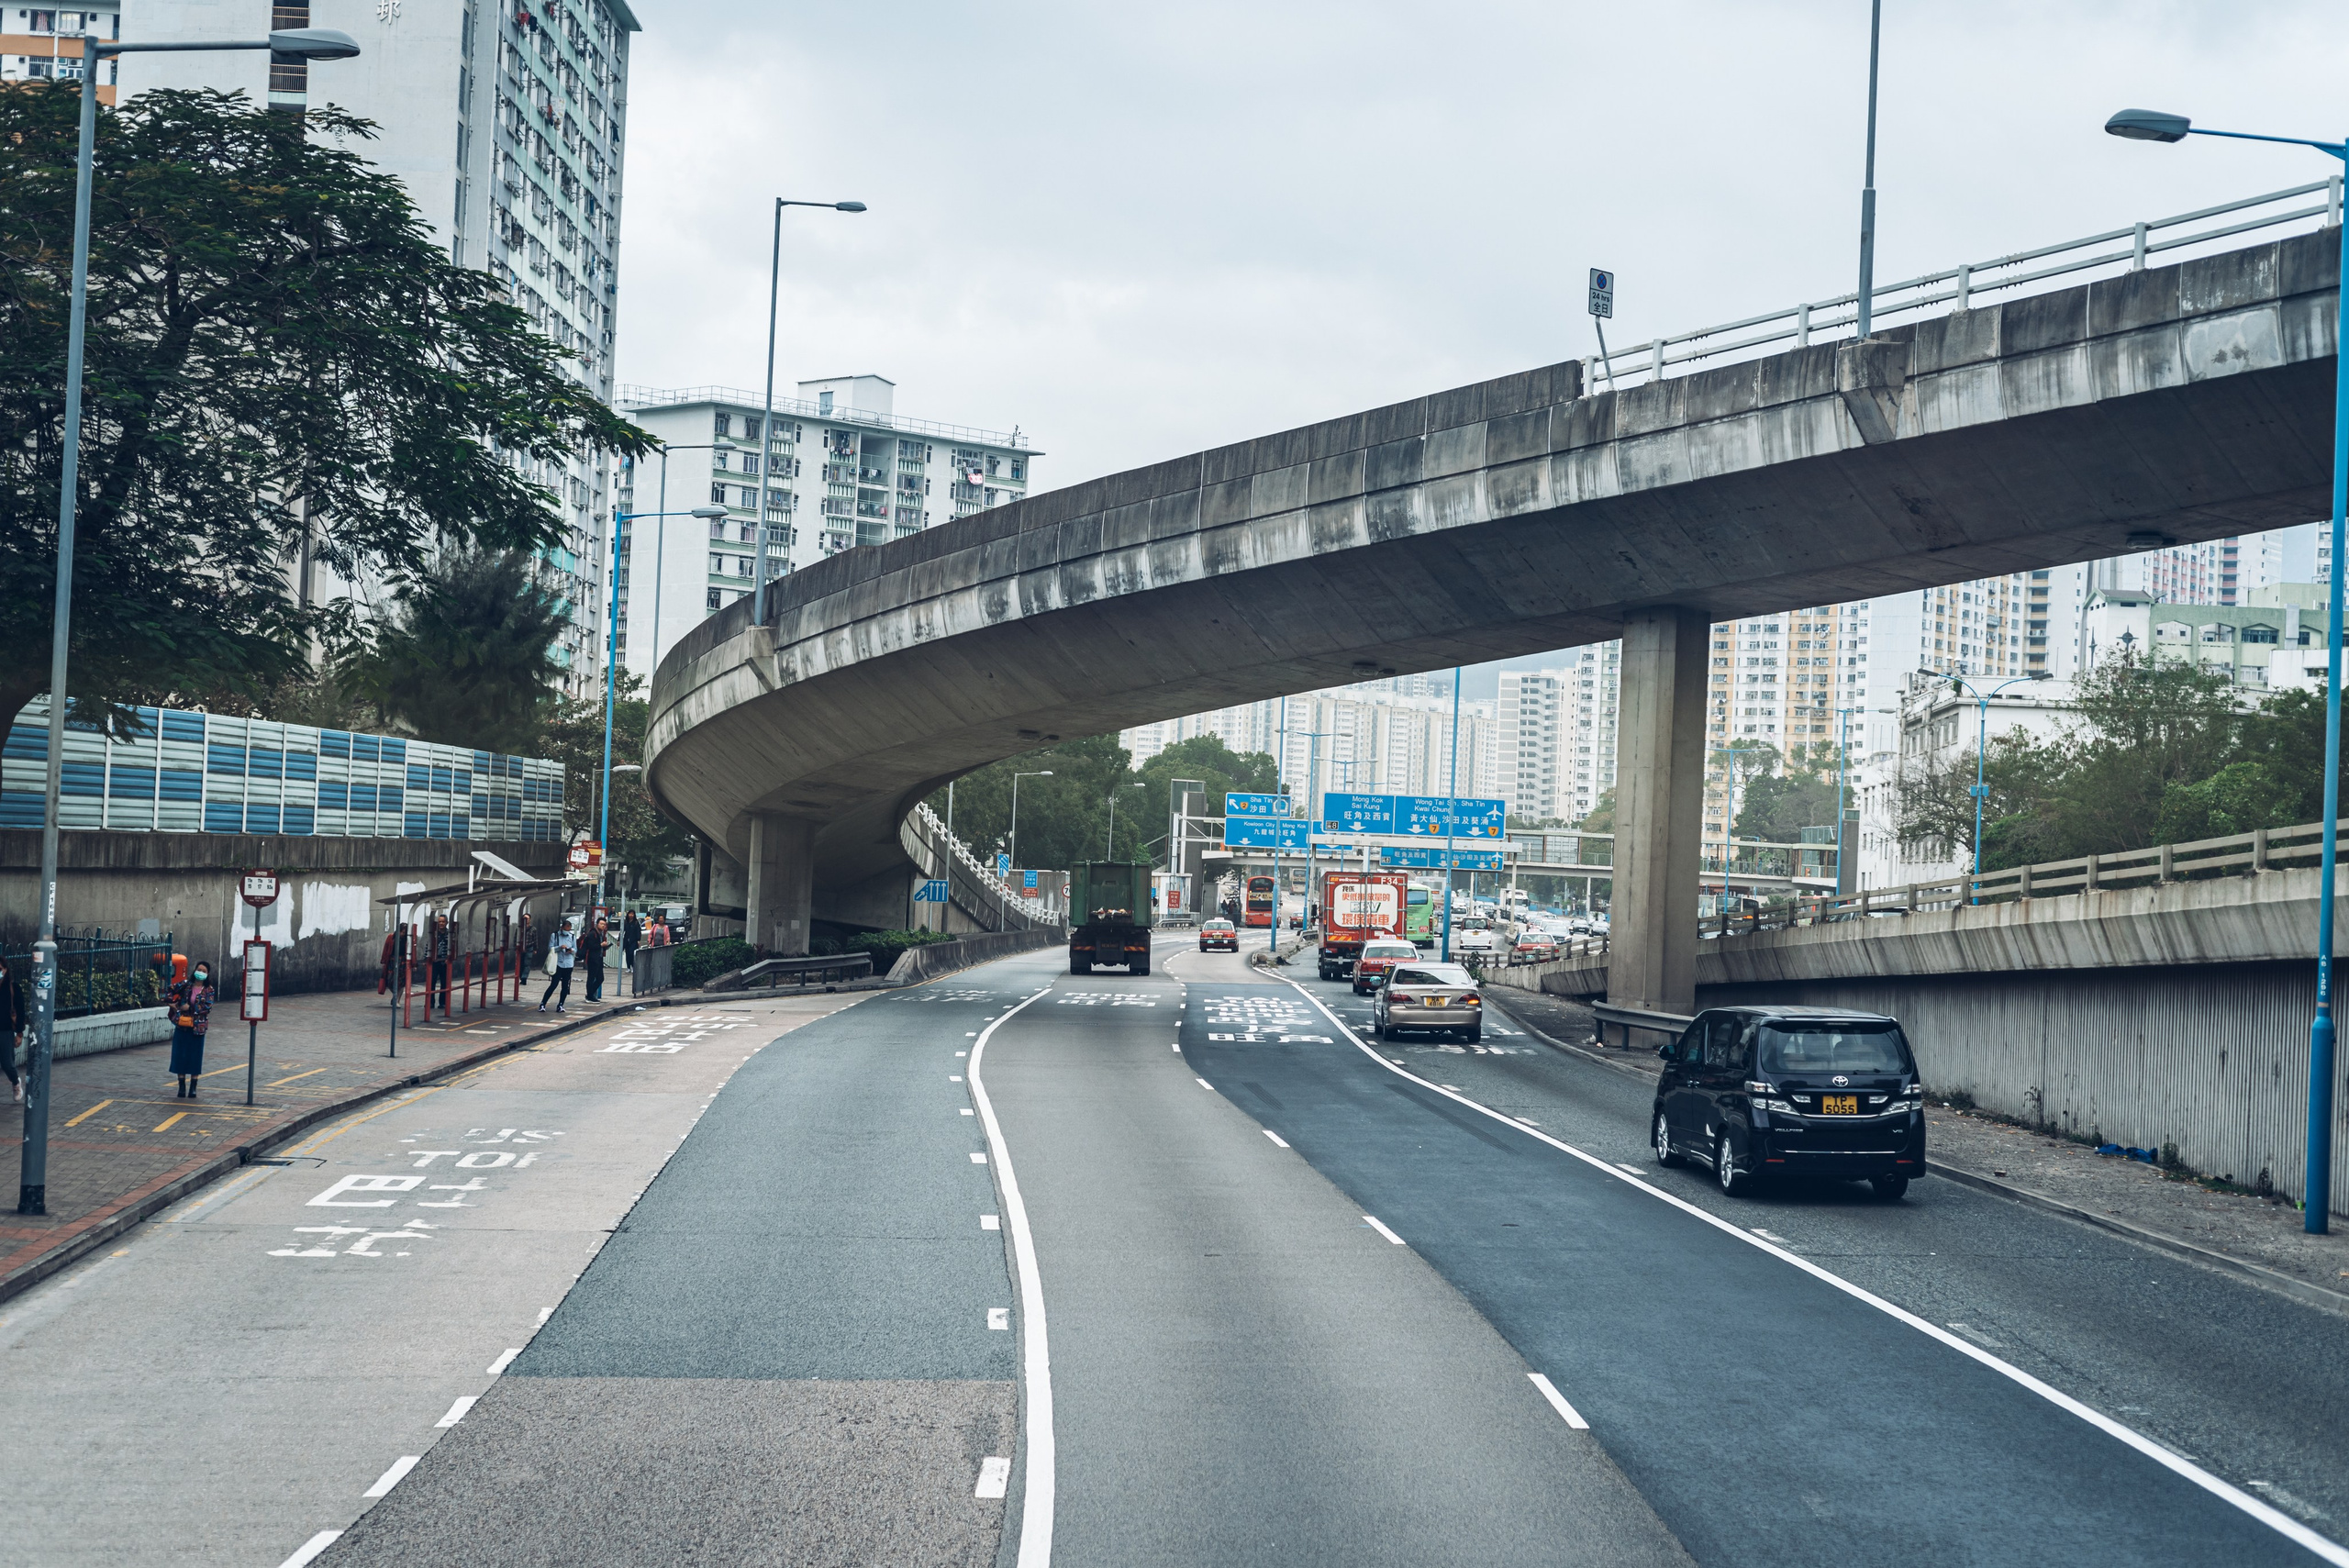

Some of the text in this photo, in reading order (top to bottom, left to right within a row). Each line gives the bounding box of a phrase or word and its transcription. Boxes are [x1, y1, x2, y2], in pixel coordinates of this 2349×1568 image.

[1592, 292, 1610, 303] 24 hrs
[1593, 301, 1609, 314] 全日
[1352, 795, 1369, 804] Mong
[1415, 798, 1433, 806] Wong
[1434, 798, 1444, 806] Tai
[1249, 805, 1267, 813] 沙田
[1343, 811, 1391, 821] 旺角及西貢
[1380, 877, 1398, 885] F34
[622, 1022, 759, 1030] STOP
[1241, 1024, 1290, 1034] 及
[608, 1029, 714, 1041] 巴士
[1208, 1032, 1334, 1044] 旺角
[593, 1041, 691, 1054] 站
[1832, 1095, 1847, 1105] TP
[1825, 1105, 1855, 1114] 5055
[305, 1174, 489, 1208] 巴士
